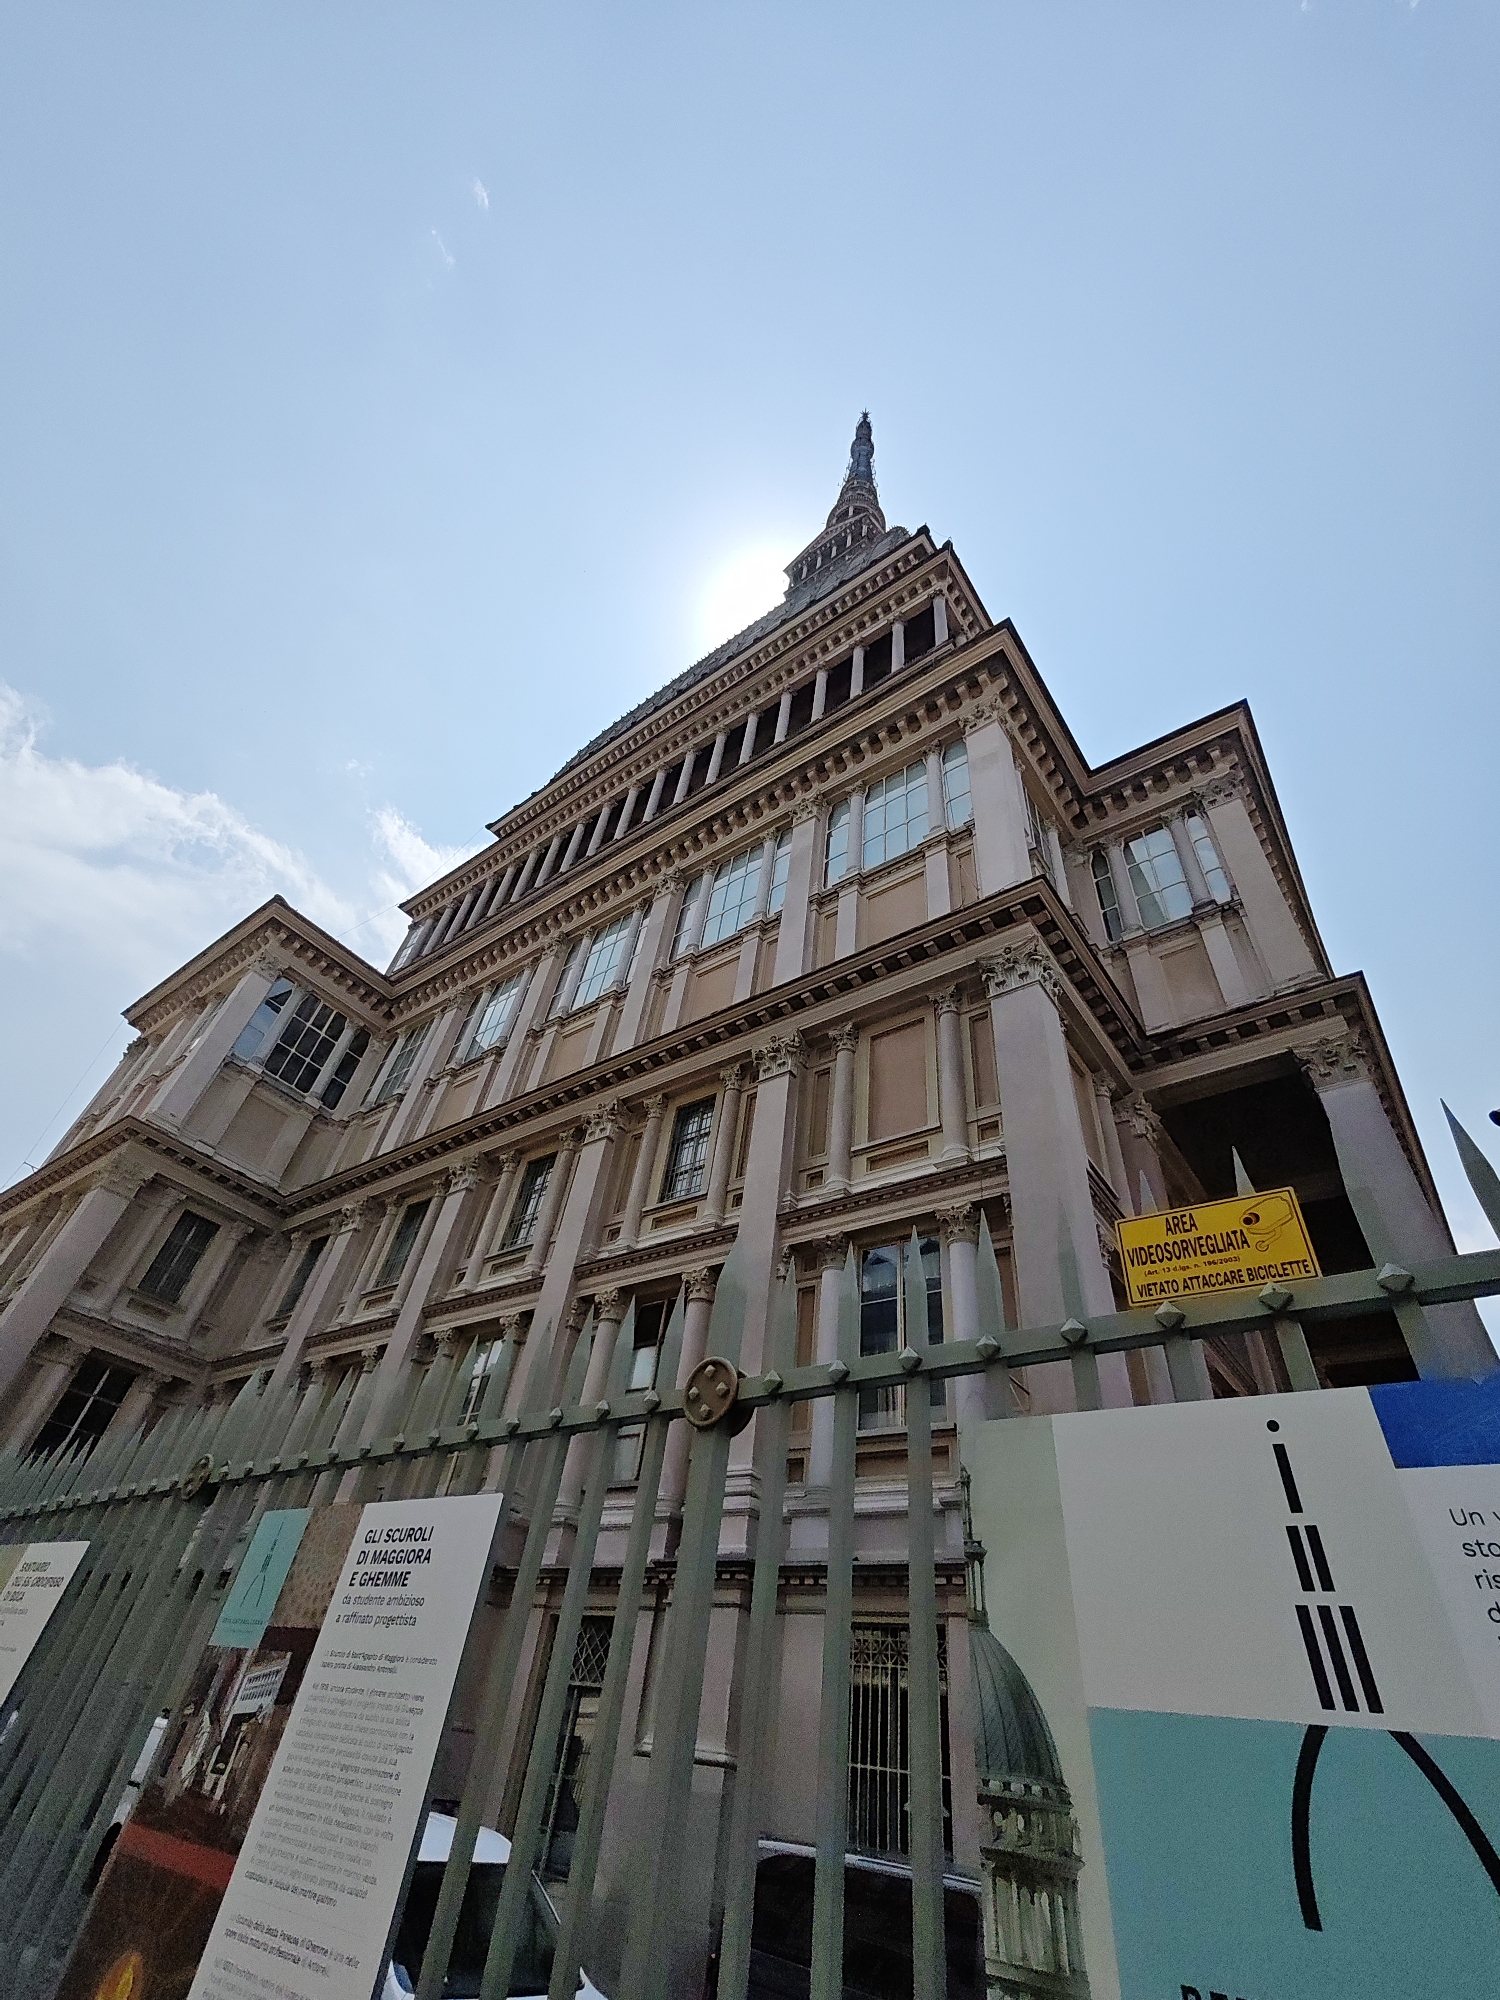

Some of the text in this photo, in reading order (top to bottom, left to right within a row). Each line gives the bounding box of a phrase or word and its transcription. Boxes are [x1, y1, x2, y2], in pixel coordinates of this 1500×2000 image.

[1165, 1213, 1198, 1236] AREA
[1126, 1229, 1250, 1268] VIDEOSORVEGLIATA
[1144, 1269, 1159, 1277] (Art.
[1203, 1256, 1240, 1267] 196/2003)
[1136, 1259, 1312, 1298] VIETATO ATTACCARE BICICLETTE
[1449, 1508, 1485, 1526] Un
[364, 1526, 435, 1544] GLI SCUROLI
[356, 1548, 432, 1565] DI MAGGIORA
[348, 1571, 412, 1587] E GHEMME
[342, 1593, 425, 1607] da studente ambizioso
[335, 1611, 417, 1629] a raffinato progettista
